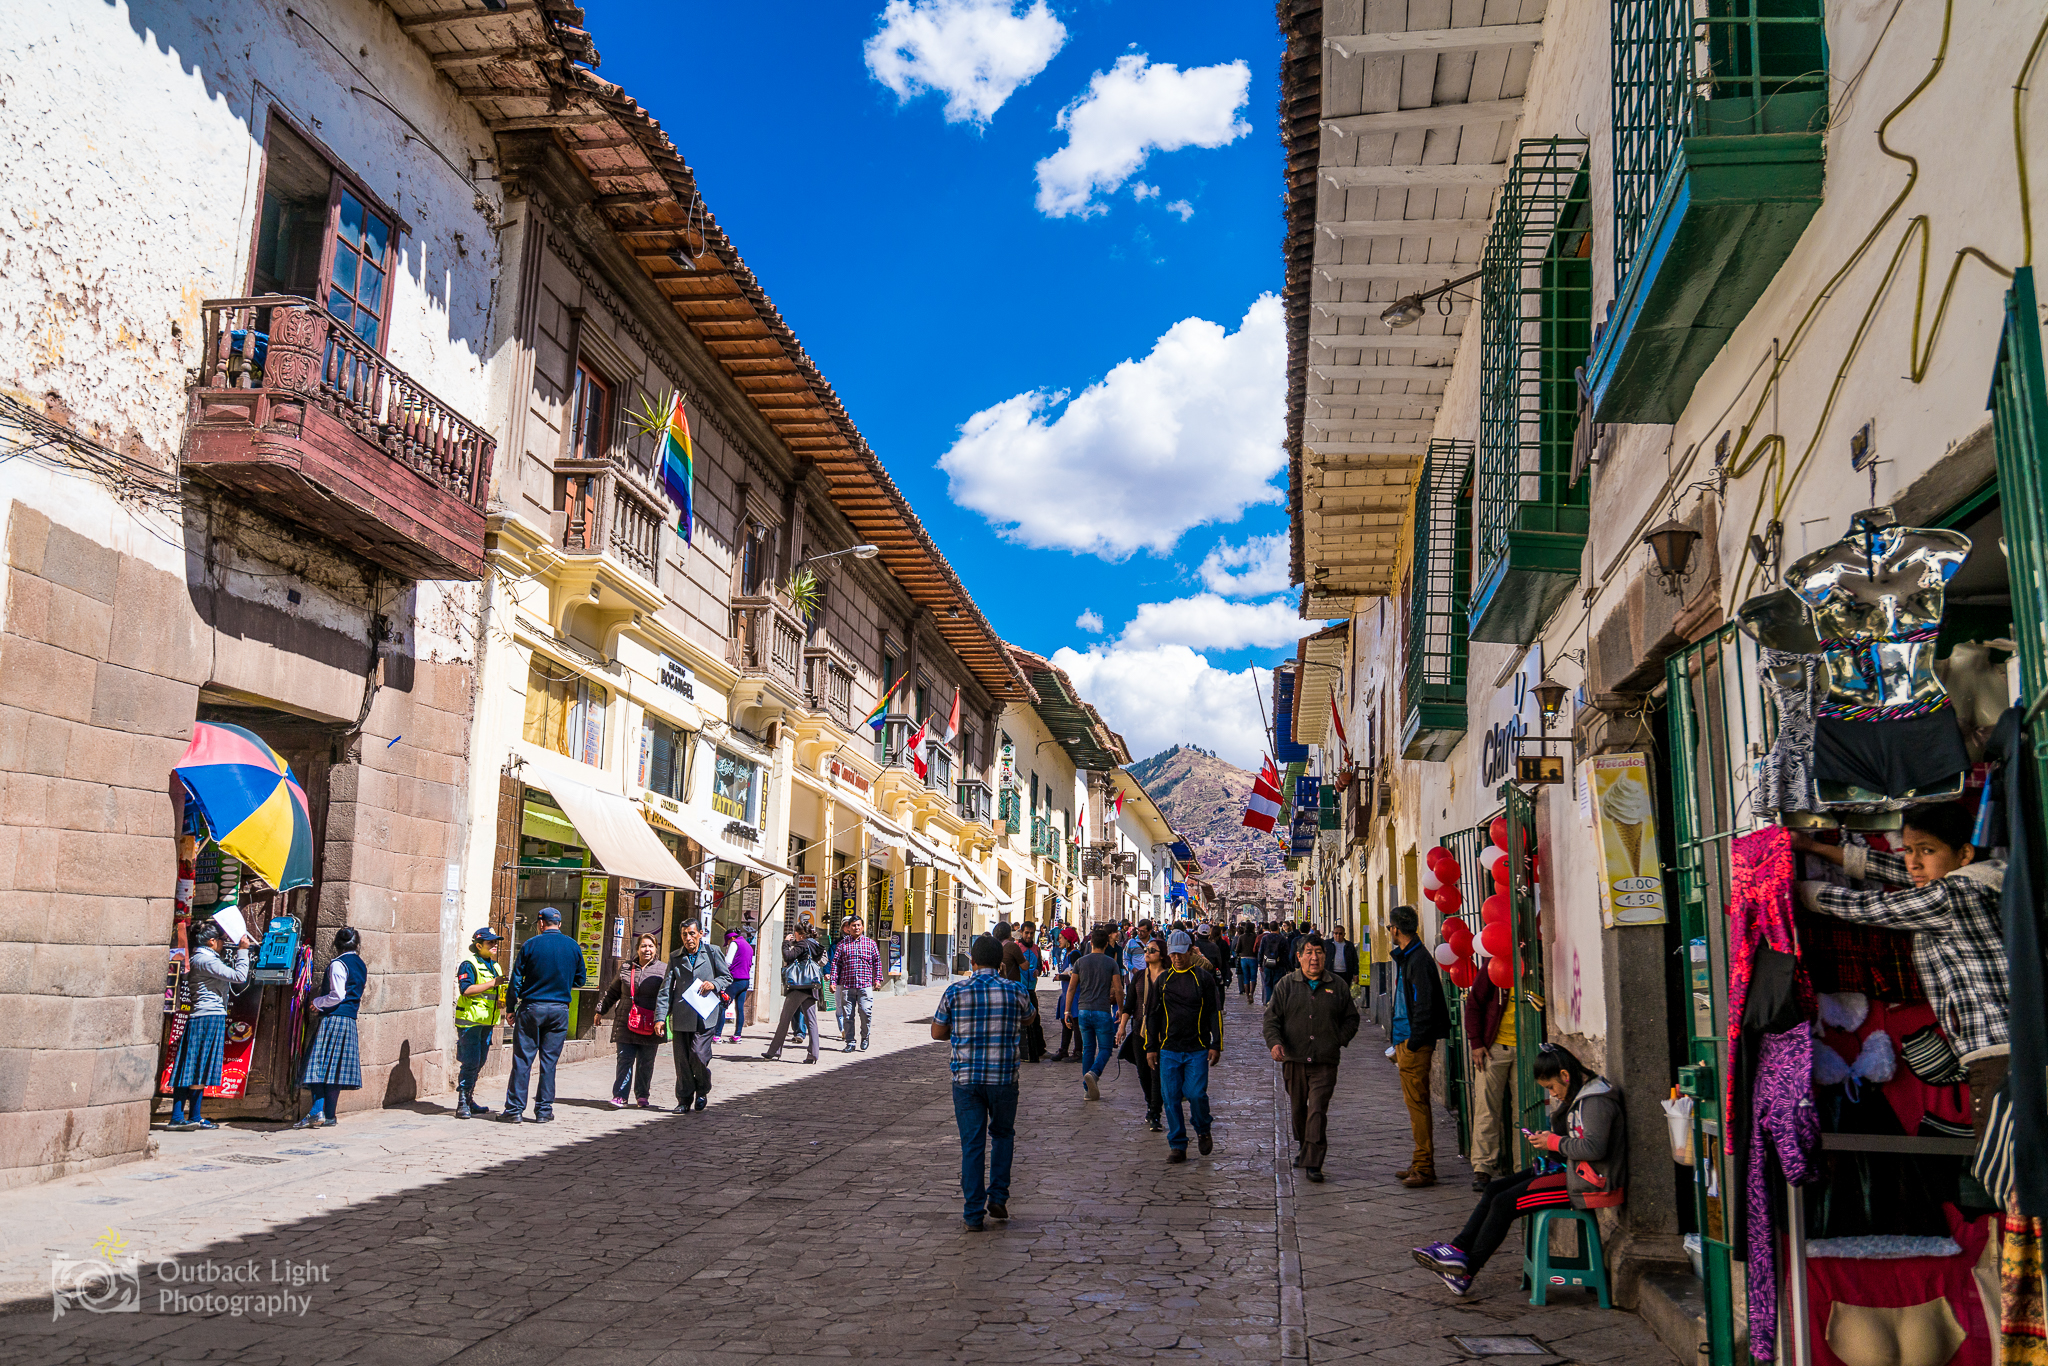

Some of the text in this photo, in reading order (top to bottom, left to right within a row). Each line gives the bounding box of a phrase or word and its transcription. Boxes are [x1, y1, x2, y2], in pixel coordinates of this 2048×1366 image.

[661, 668, 694, 701] BOCANGEL
[1482, 713, 1520, 788] Claro
[1596, 757, 1645, 769] Helados
[712, 792, 743, 820] TATTOO
[760, 772, 768, 830] TATTOO
[1623, 878, 1653, 890] 1.00
[1625, 894, 1655, 905] 1.50
